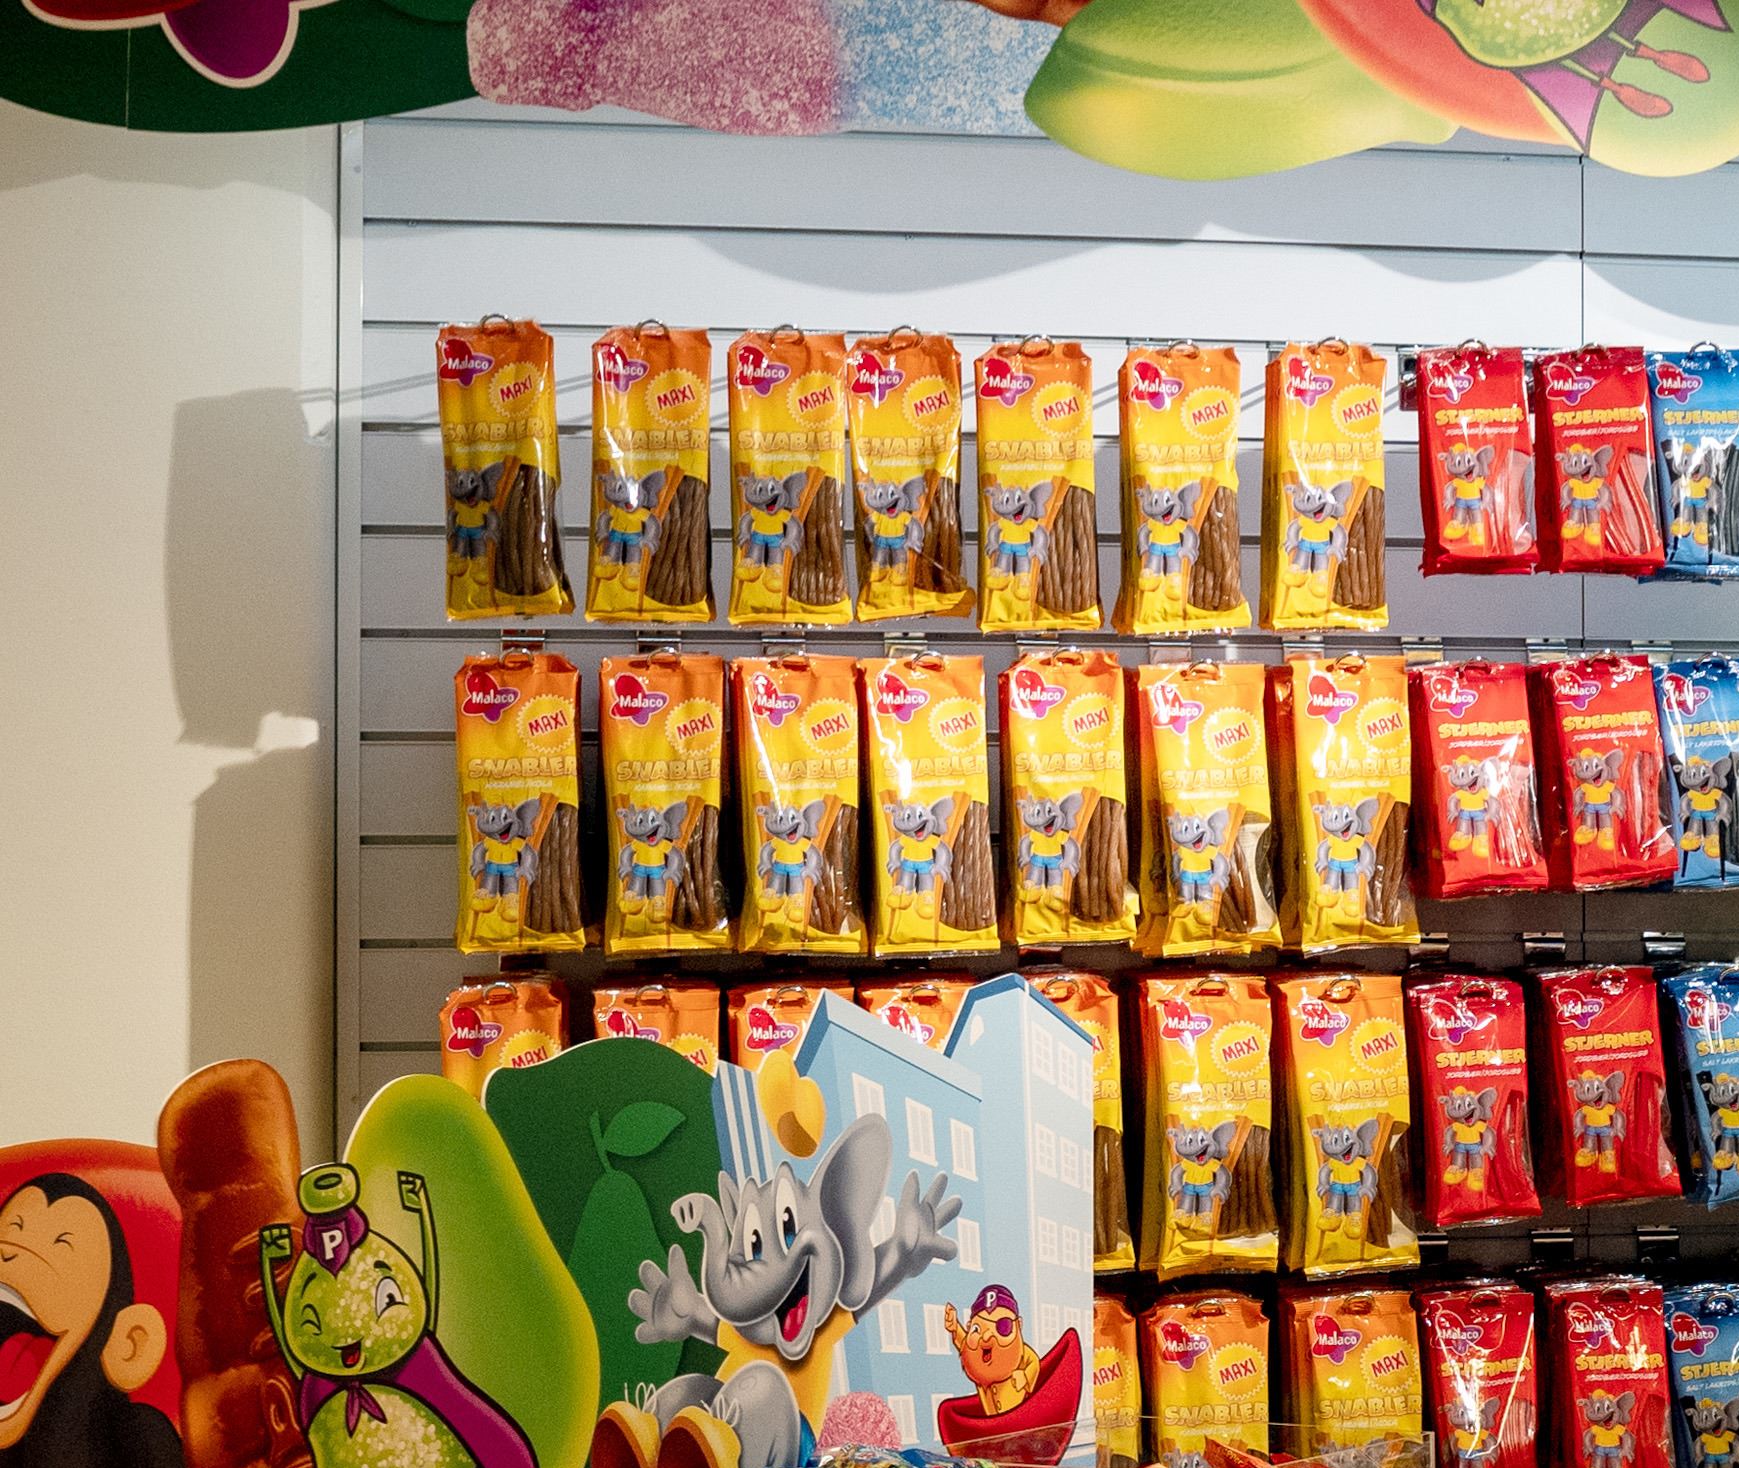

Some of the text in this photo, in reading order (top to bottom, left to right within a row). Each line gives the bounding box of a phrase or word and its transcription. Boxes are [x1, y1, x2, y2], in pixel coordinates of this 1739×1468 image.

[448, 356, 490, 371] Malaco
[500, 377, 533, 402] MAXI
[989, 376, 1031, 390] Malaco
[657, 389, 696, 410] MAXI
[1043, 400, 1080, 421] MAXI
[1342, 399, 1378, 423] MAXI
[1552, 409, 1644, 427] STJERNER
[472, 691, 514, 704] Malaco
[1312, 695, 1353, 707] Malaco
[528, 711, 568, 737] MAXI
[676, 713, 713, 740] MAXI
[1074, 708, 1110, 733] MAXI
[1366, 712, 1403, 738] MAXI
[1564, 1031, 1654, 1053] STJERNER
[1436, 1048, 1526, 1069] STJERNER
[322, 1230, 344, 1259] P
[985, 1291, 997, 1307] P
